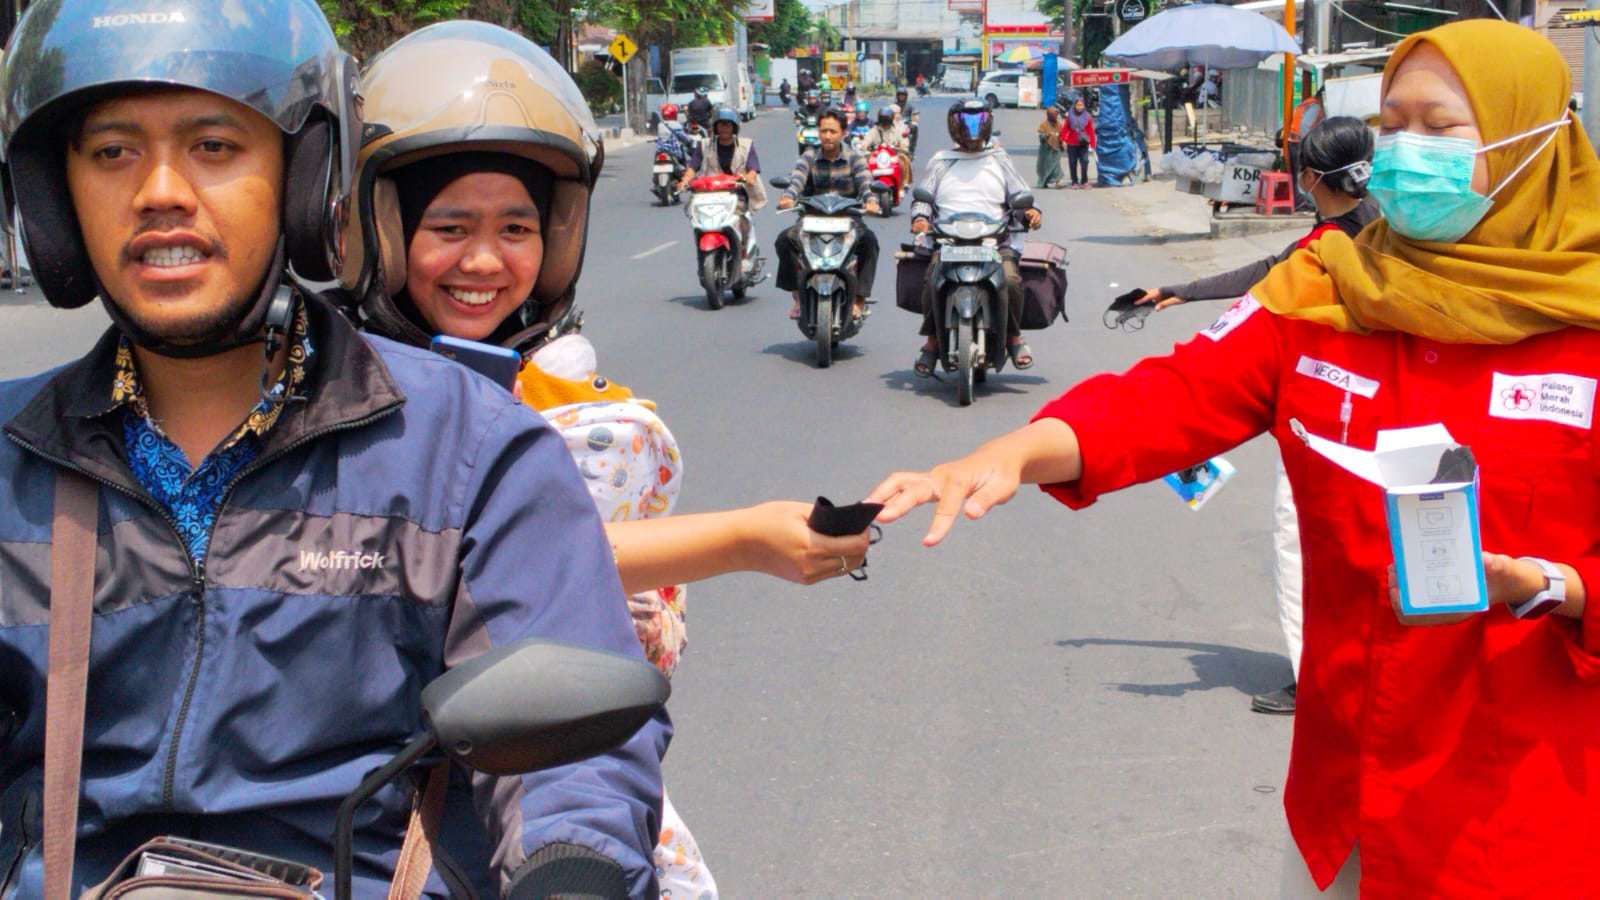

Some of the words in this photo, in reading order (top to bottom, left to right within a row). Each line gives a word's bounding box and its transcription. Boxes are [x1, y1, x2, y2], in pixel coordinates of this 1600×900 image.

[93, 12, 185, 28] HONDA
[1243, 183, 1252, 195] 2
[1315, 362, 1350, 388] VEGA
[1541, 382, 1573, 394] Palang
[1541, 393, 1570, 403] Merah
[1540, 404, 1583, 418] Indonesia
[299, 550, 384, 570] Wolfrick
